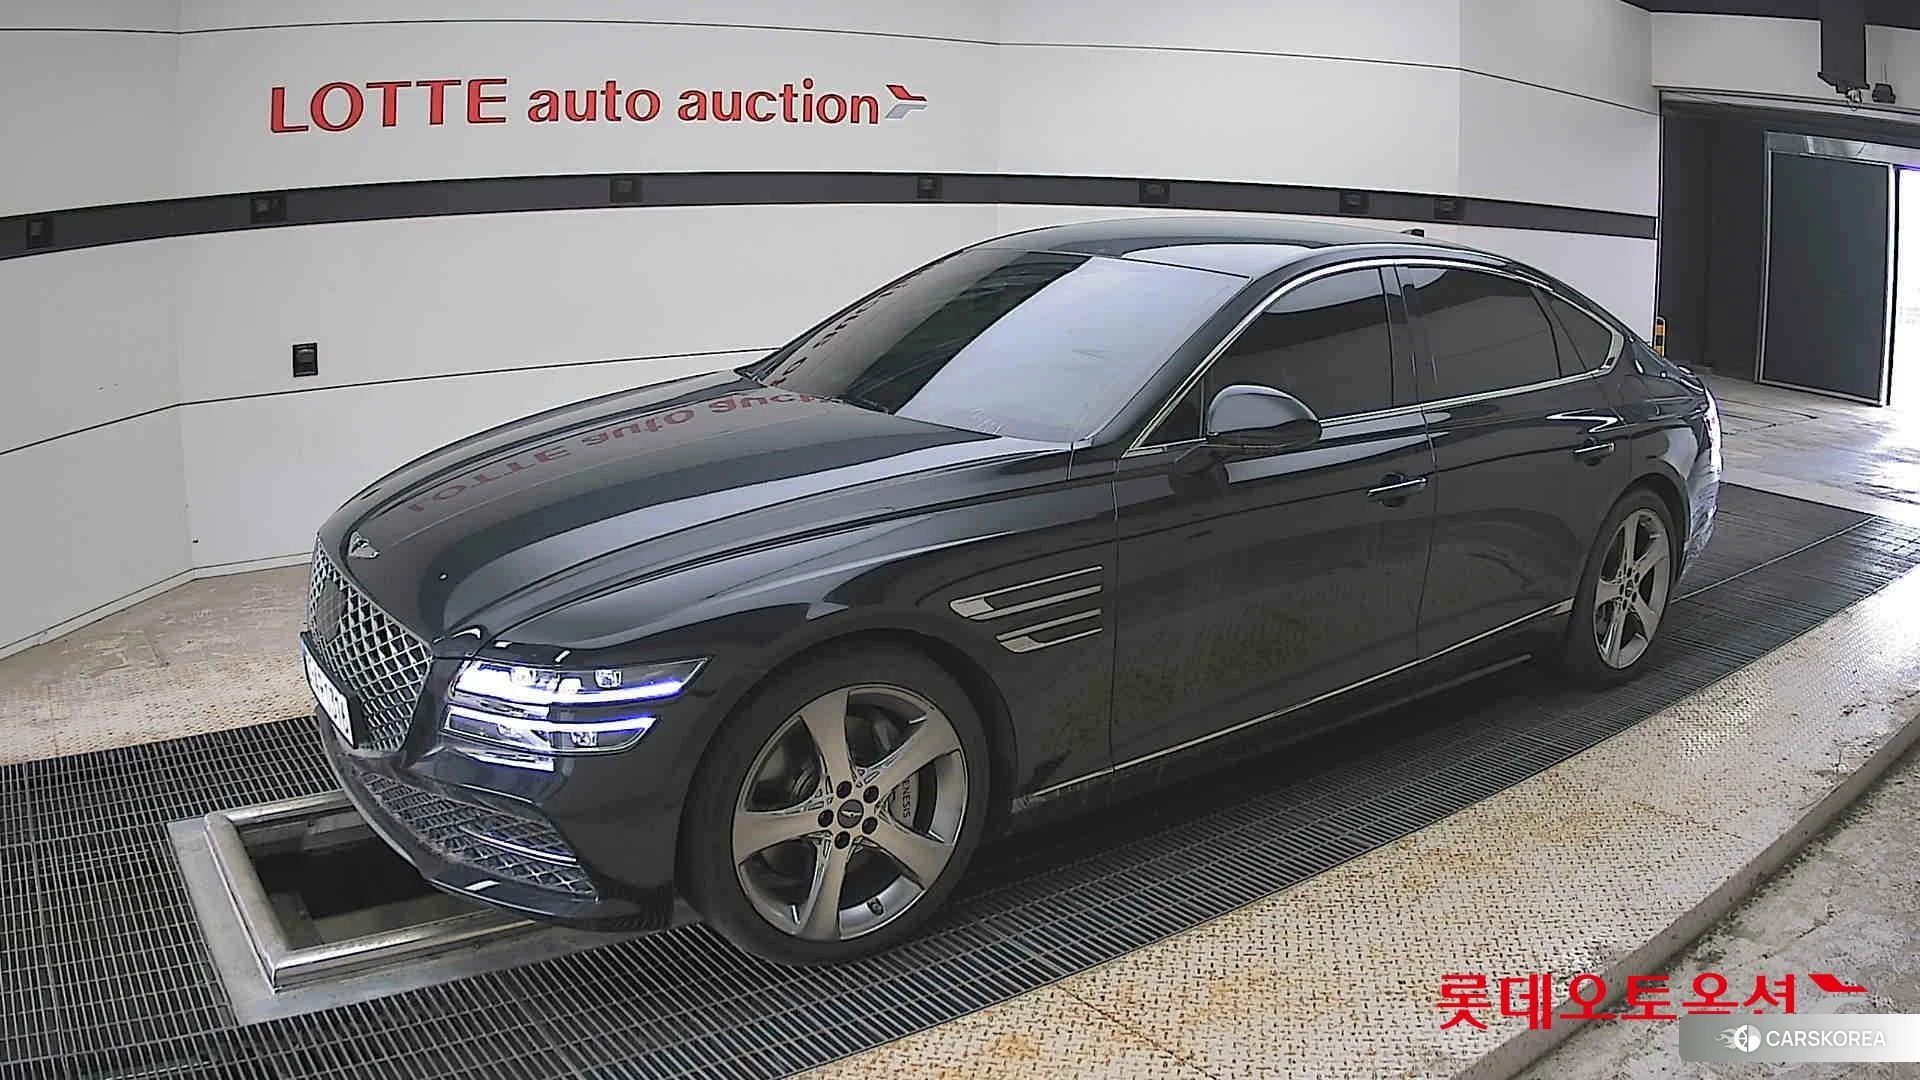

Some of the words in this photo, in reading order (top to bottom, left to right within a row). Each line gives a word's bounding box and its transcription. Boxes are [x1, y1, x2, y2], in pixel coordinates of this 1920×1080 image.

[271, 79, 507, 133] LOTTE
[527, 79, 661, 123] auto
[677, 78, 879, 124] auction
